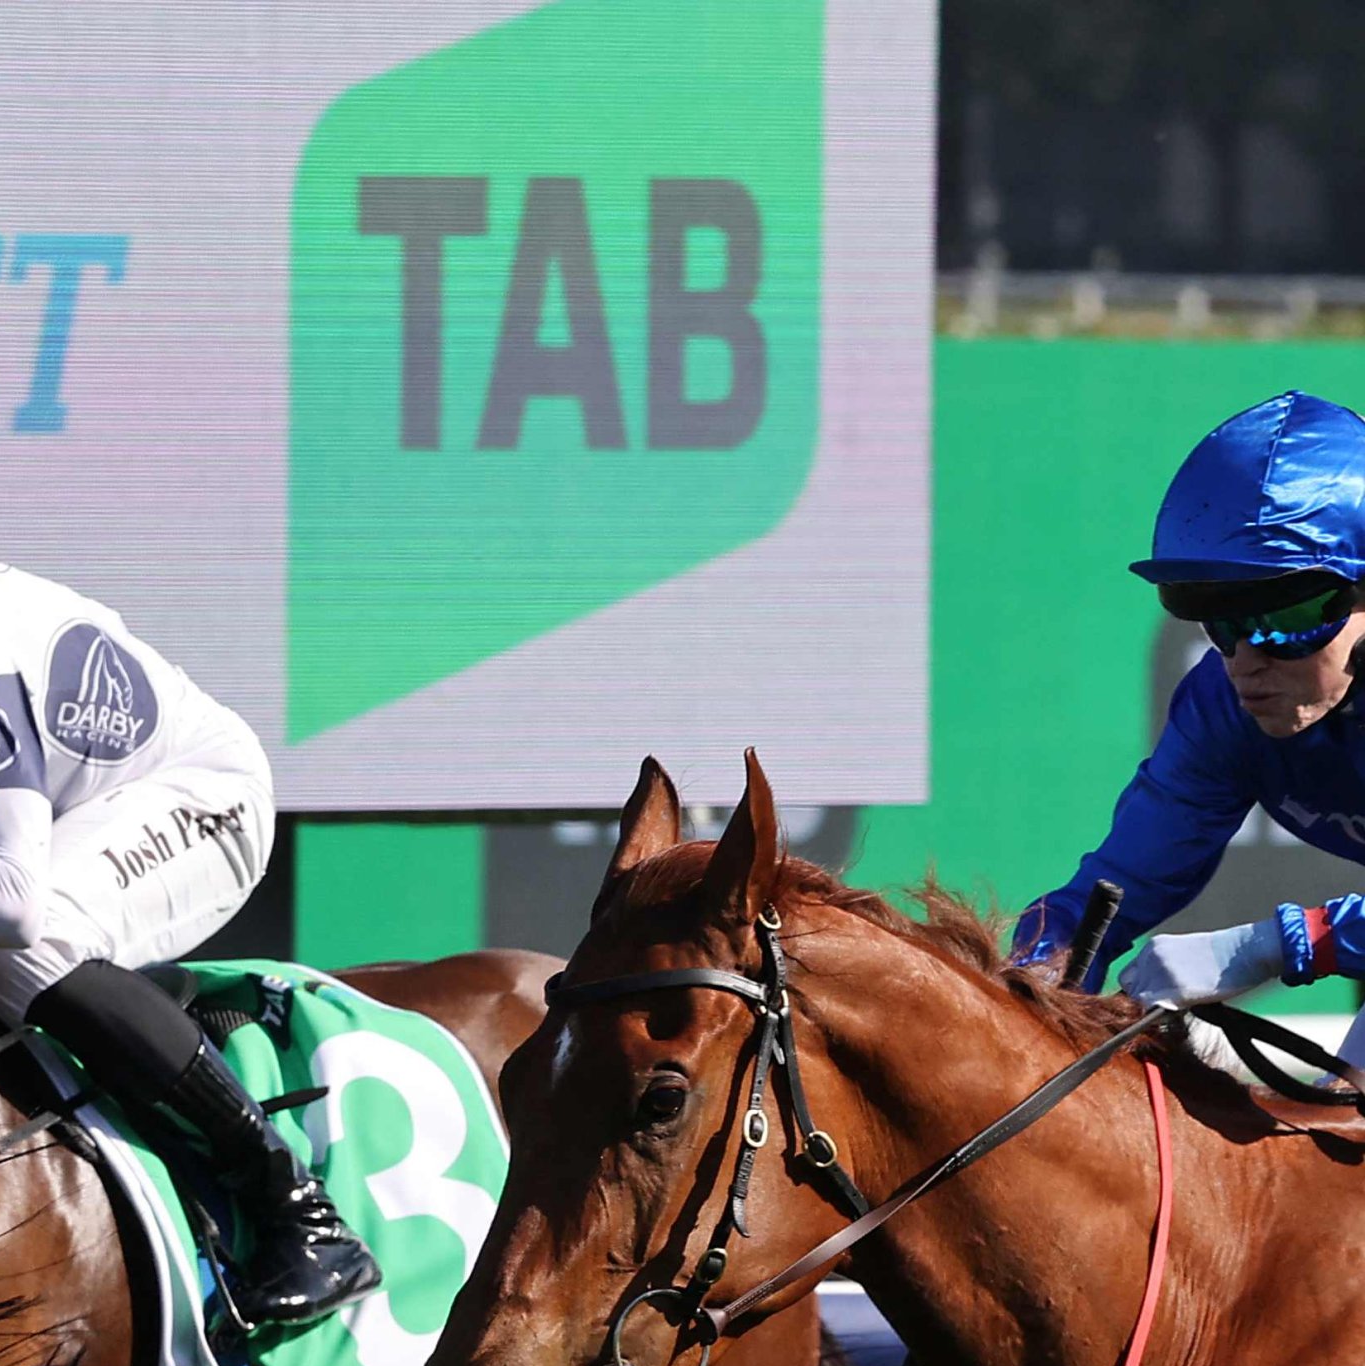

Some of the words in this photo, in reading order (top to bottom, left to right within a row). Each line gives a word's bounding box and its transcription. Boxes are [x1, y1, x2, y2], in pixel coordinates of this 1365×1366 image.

[356, 176, 769, 451] TAB
[56, 729, 135, 752] RACING
[57, 702, 144, 739] DARBY
[99, 824, 175, 890] Josh
